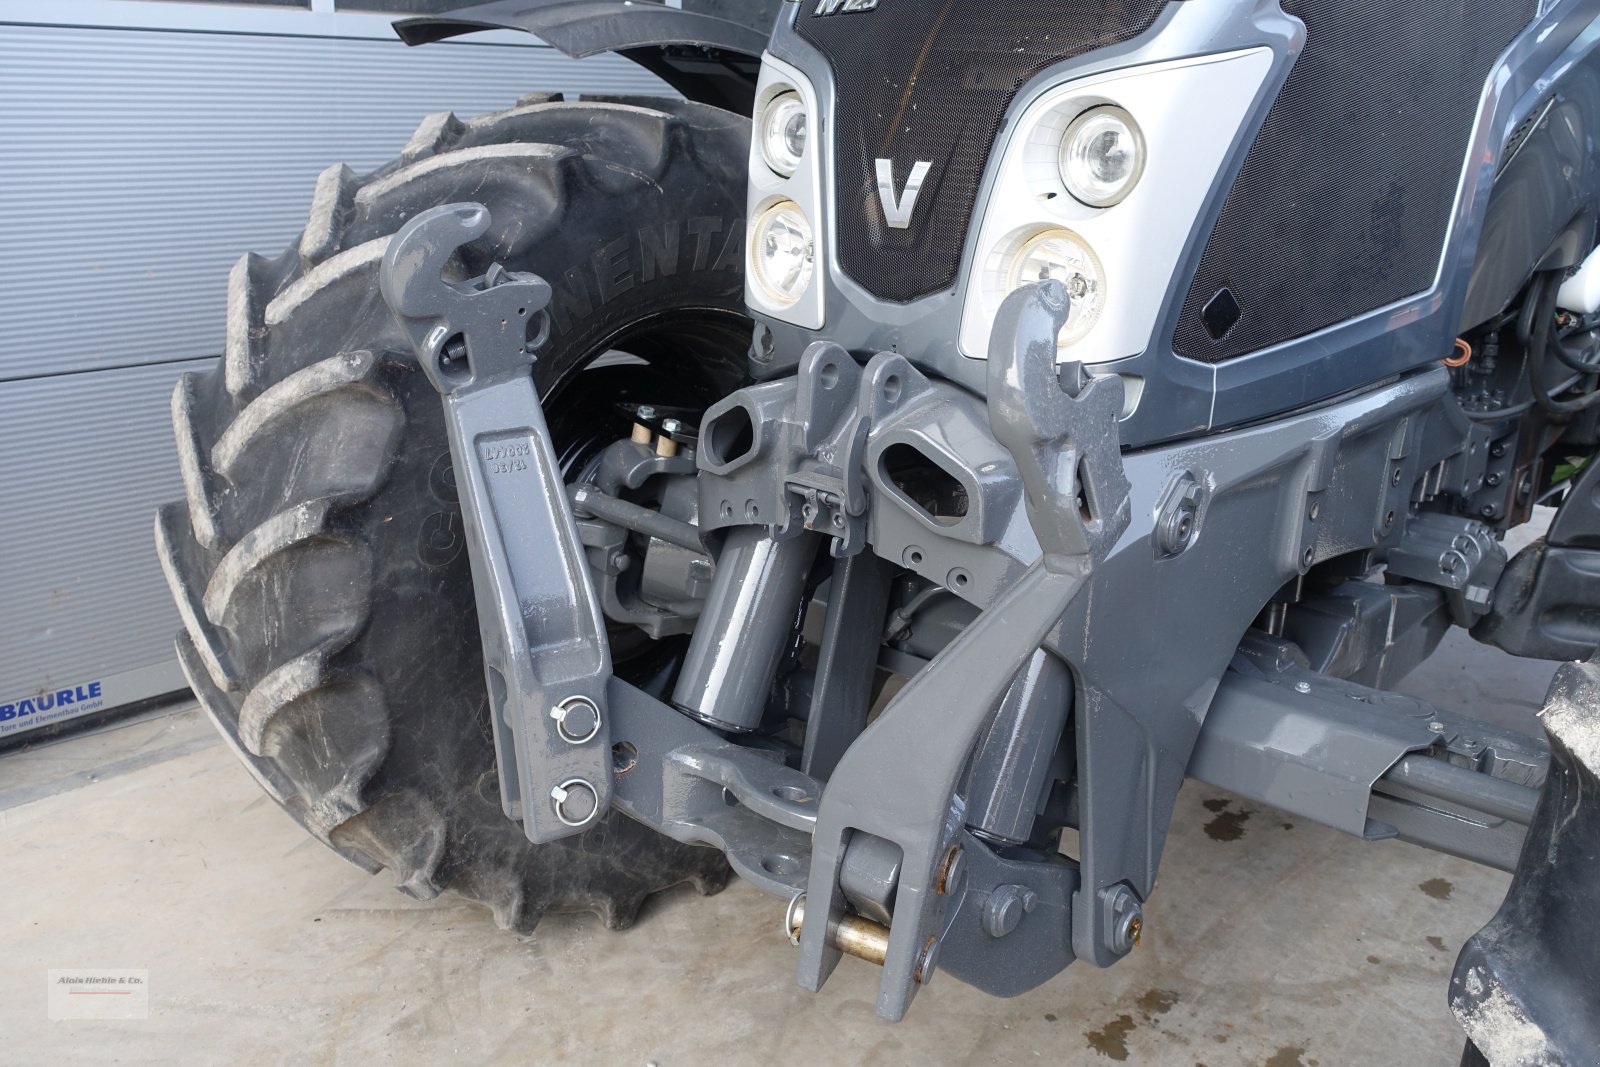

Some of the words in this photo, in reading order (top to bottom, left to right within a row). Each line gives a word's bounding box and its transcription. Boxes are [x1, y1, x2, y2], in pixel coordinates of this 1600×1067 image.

[875, 158, 932, 229] V
[0, 681, 102, 721] BÄURLE
[0, 724, 17, 733] Tore
[19, 719, 34, 728] und
[35, 708, 79, 723] Elementbau
[80, 700, 103, 711] GmbH
